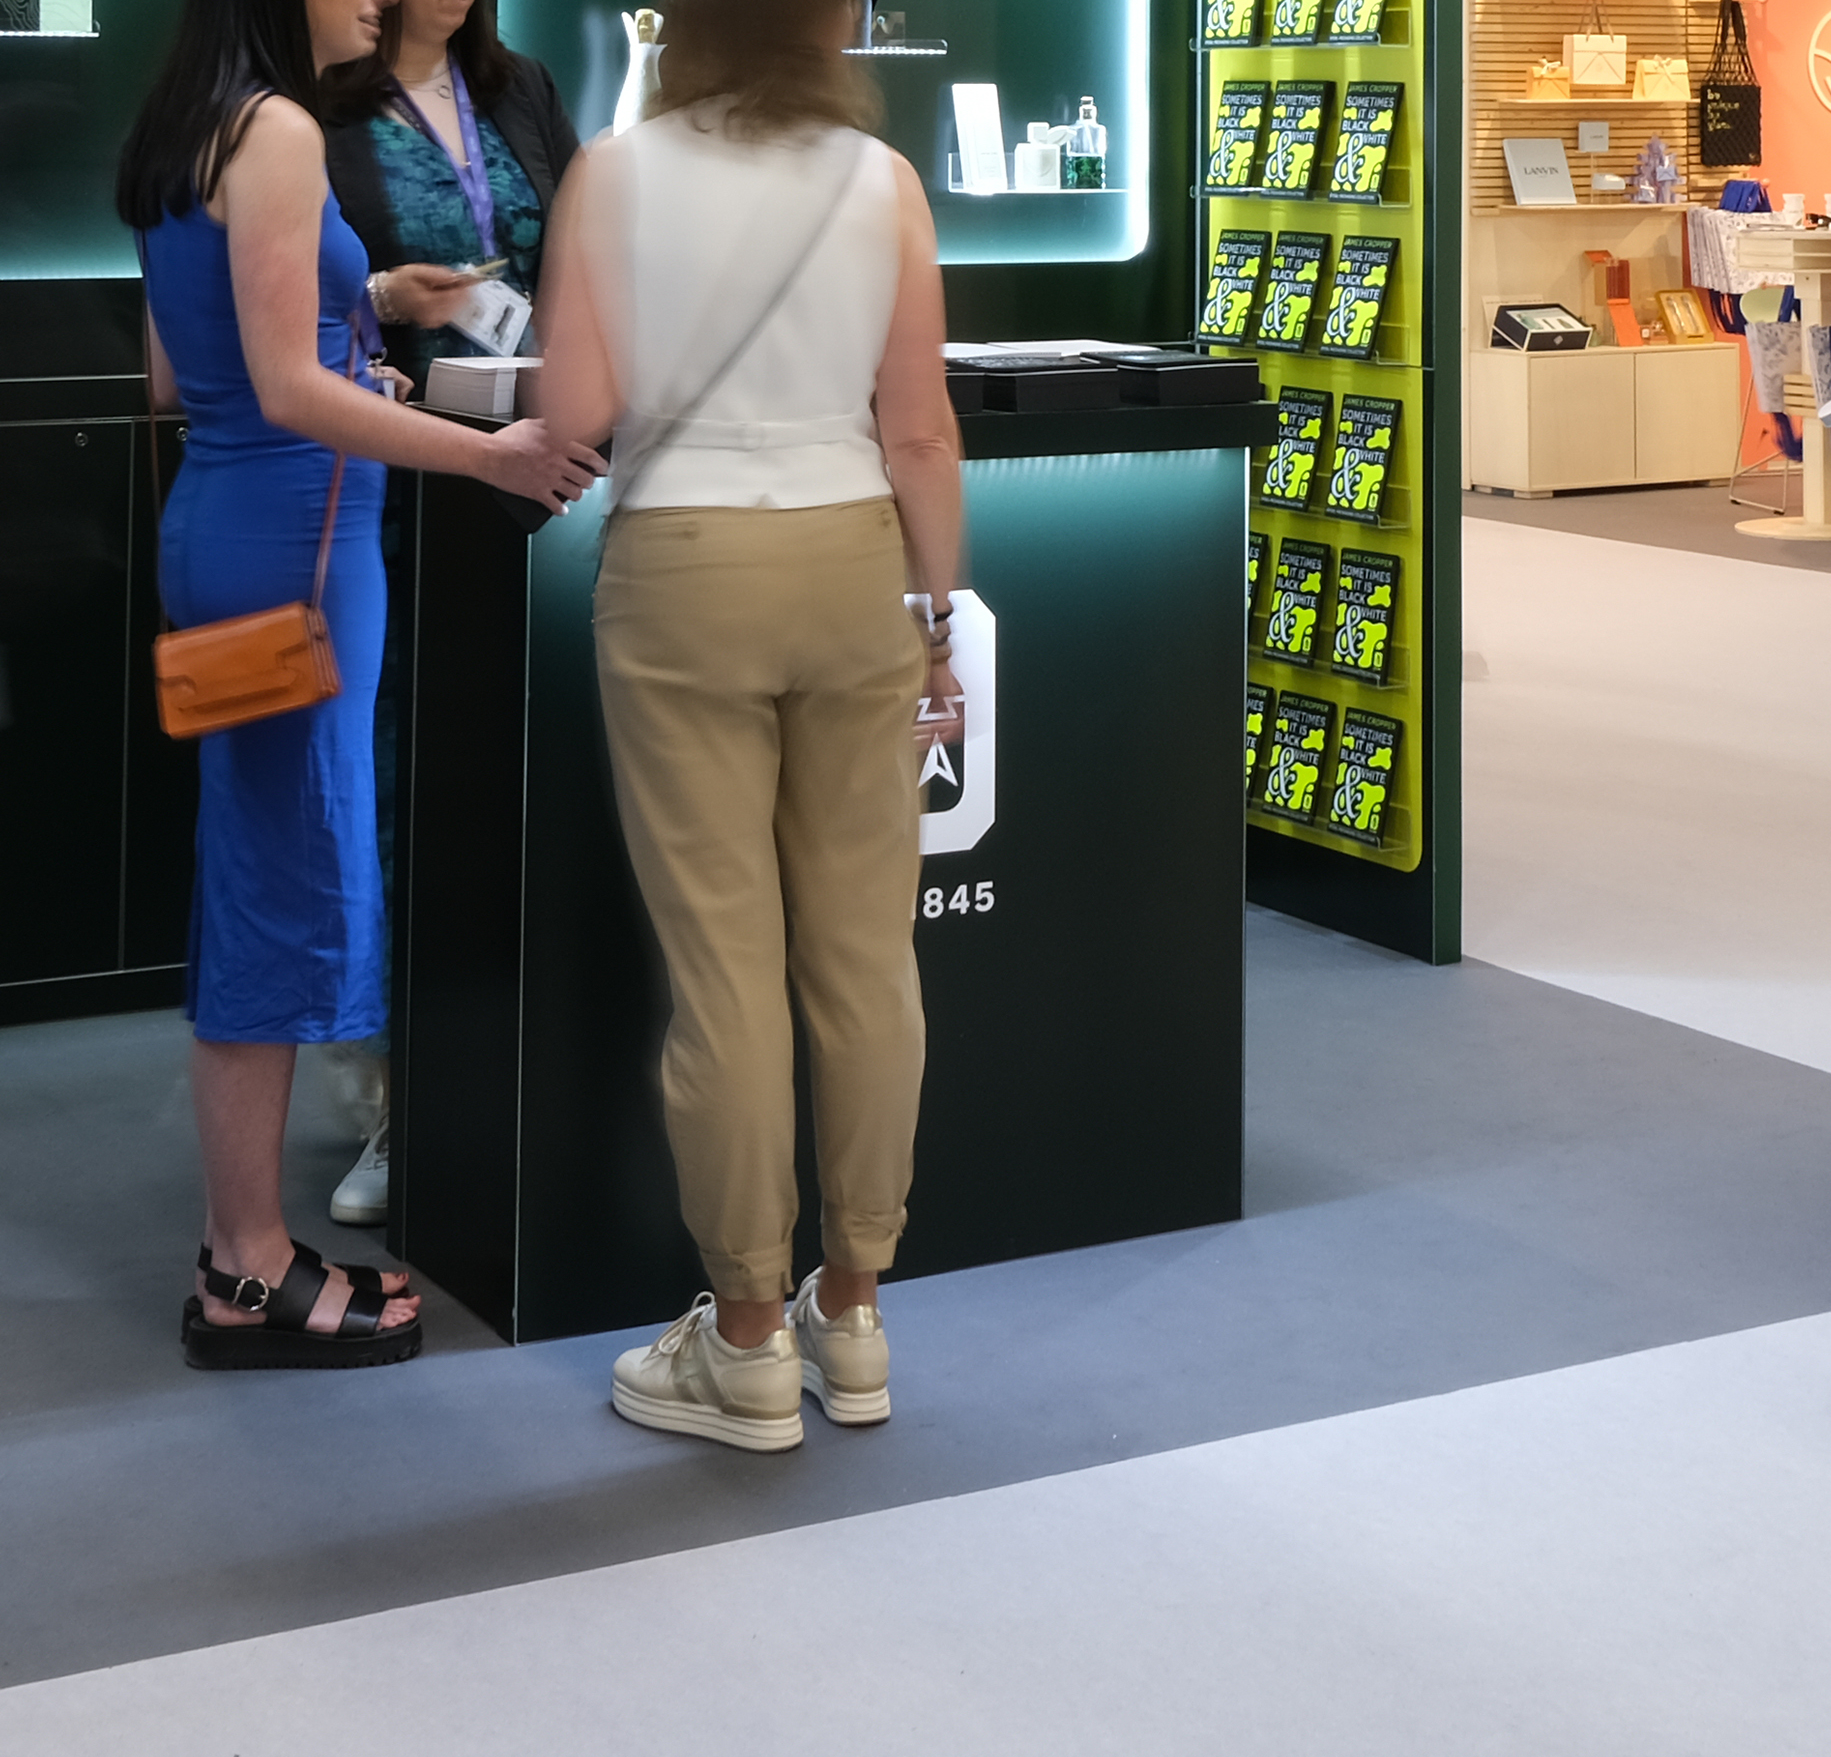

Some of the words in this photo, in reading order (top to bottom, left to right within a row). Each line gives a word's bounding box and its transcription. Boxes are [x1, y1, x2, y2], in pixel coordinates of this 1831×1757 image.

[1221, 95, 1262, 105] SOMETIMES
[1275, 95, 1322, 106] SOMETIMES
[1346, 97, 1394, 108] SOMETIMES
[1230, 106, 1238, 116] IT
[1239, 106, 1246, 116] IS
[1287, 107, 1295, 117] IT
[1296, 107, 1304, 117] IS
[1358, 109, 1367, 119] IT
[1368, 109, 1377, 119] IS
[1217, 118, 1240, 128] BLACK
[1272, 119, 1297, 129] BLACK
[1342, 121, 1369, 131] BLACK
[1209, 129, 1234, 177] &
[1234, 130, 1255, 140] WHITE
[1265, 131, 1293, 180] &
[1291, 132, 1315, 142] WHITE
[1334, 133, 1364, 183] &
[1363, 134, 1387, 144] WHITE
[1523, 166, 1559, 175] LANVIN
[1218, 243, 1262, 256] SOMETIMES
[1275, 246, 1320, 259] SOMETIMES
[1341, 250, 1389, 263] SOMETIMES
[1228, 255, 1236, 265] IT
[1237, 256, 1245, 266] IS
[1285, 258, 1294, 268] IT
[1295, 259, 1303, 269] IS
[1213, 266, 1238, 277] BLACK
[1270, 269, 1296, 281] BLACK
[1352, 263, 1361, 273] IT
[1362, 264, 1370, 274] IS
[1335, 274, 1362, 286] BLACK
[1204, 278, 1232, 326] &
[1231, 280, 1254, 290] WHITE
[1261, 282, 1289, 331] &
[1289, 283, 1312, 295] WHITE
[1326, 287, 1356, 337] &
[1355, 288, 1380, 300] WHITE
[1278, 401, 1323, 417] SOMETIMES
[1289, 414, 1297, 425] IT
[1298, 416, 1306, 427] IS
[1342, 409, 1392, 426] SOMETIMES
[1278, 425, 1299, 438] LACK
[1354, 423, 1363, 434] IT
[1365, 425, 1373, 436] IS
[1338, 434, 1366, 447] BLACK
[1266, 439, 1293, 488] &
[1293, 440, 1315, 453] WHITE
[1331, 448, 1361, 499] &
[1359, 450, 1385, 463] WHITE
[1279, 554, 1323, 571] SOMETIMES
[1289, 567, 1297, 578] IT
[1298, 569, 1306, 580] IS
[1341, 565, 1391, 584] SOMETIMES
[1275, 577, 1299, 591] BLACK
[1353, 579, 1362, 591] IT
[1365, 581, 1373, 593] IS
[1339, 590, 1366, 605] BLACK
[1269, 592, 1295, 642] &
[1294, 593, 1316, 608] WHITE
[1335, 605, 1364, 657] &
[1360, 607, 1386, 622] WHITE
[1278, 707, 1326, 728] SOMETIMES
[1289, 722, 1298, 734] IT
[1299, 724, 1308, 736] IS
[1343, 724, 1393, 747] SOMETIMES
[1274, 732, 1301, 747] BLACK
[1356, 739, 1364, 752] IT
[1366, 742, 1374, 755] IS
[1340, 749, 1367, 766] BLACK
[1267, 747, 1295, 798] &
[1294, 749, 1319, 765] WHITE
[1333, 766, 1362, 818] &
[1360, 768, 1386, 785] WHITE
[911, 880, 995, 919] 845
